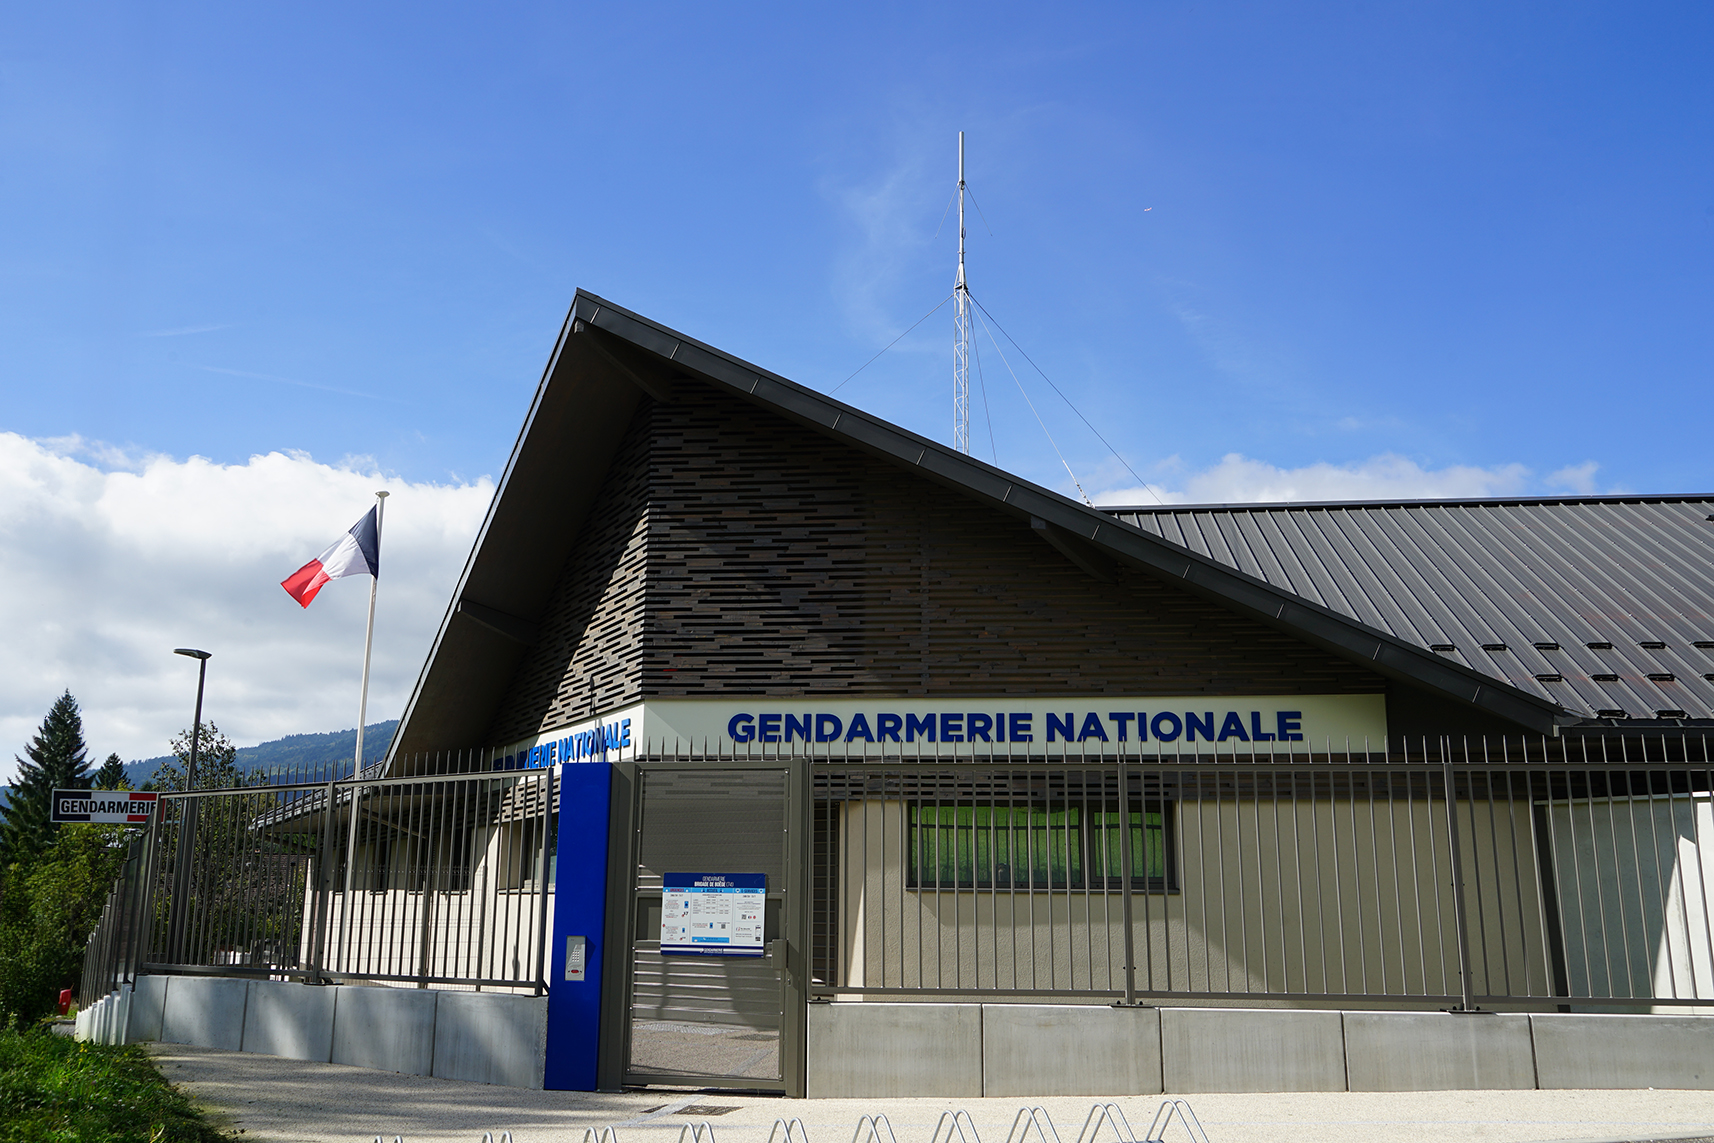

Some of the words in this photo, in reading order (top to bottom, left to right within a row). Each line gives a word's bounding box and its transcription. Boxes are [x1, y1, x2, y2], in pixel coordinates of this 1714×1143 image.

[558, 718, 631, 764] NATIONALE
[727, 712, 1033, 743] GENDARMERIE
[1046, 711, 1303, 742] NATIONALE
